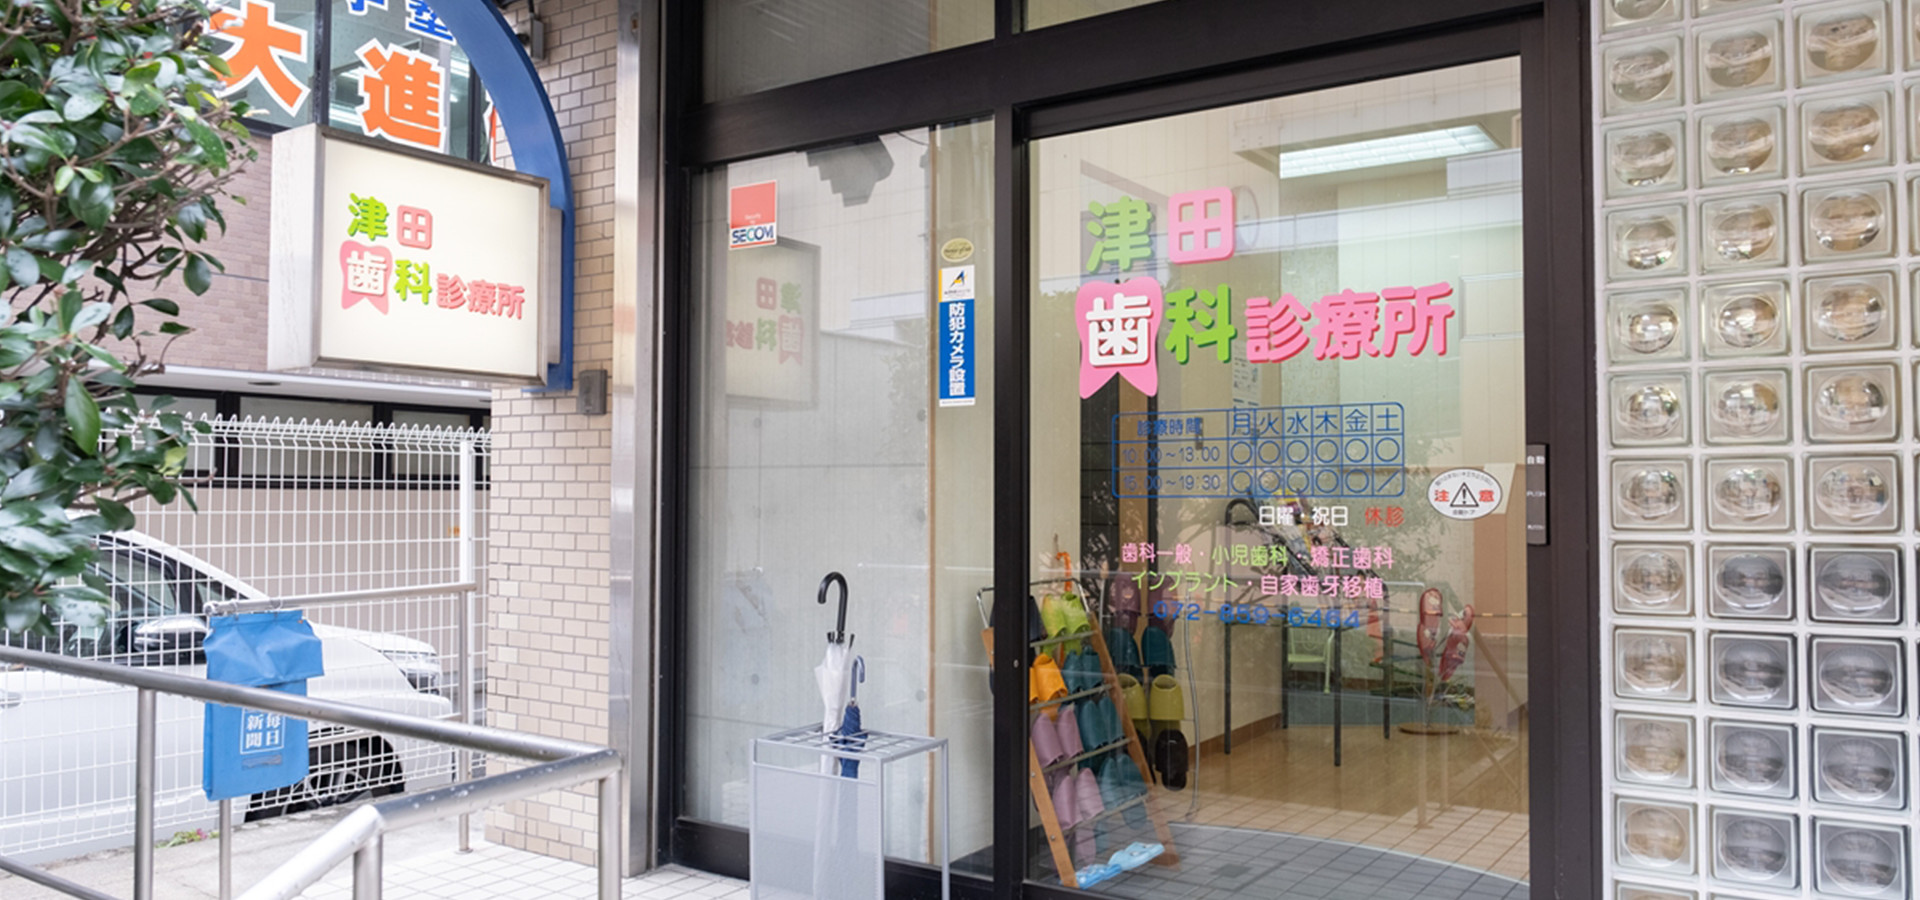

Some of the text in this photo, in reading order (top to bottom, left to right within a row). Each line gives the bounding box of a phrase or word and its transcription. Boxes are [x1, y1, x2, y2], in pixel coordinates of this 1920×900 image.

[347, 192, 433, 250] 津田
[732, 225, 774, 244] SECOM
[1086, 187, 1236, 272] 津田
[346, 251, 526, 320] 歯科診療所
[948, 302, 966, 396] 防犯カメラ設置
[1084, 281, 1455, 366] 歯科診療所
[1137, 417, 1200, 437] 診療時間
[1258, 504, 1405, 528] 日曜・祝日 休診
[1152, 600, 1360, 629] 072-859-6464
